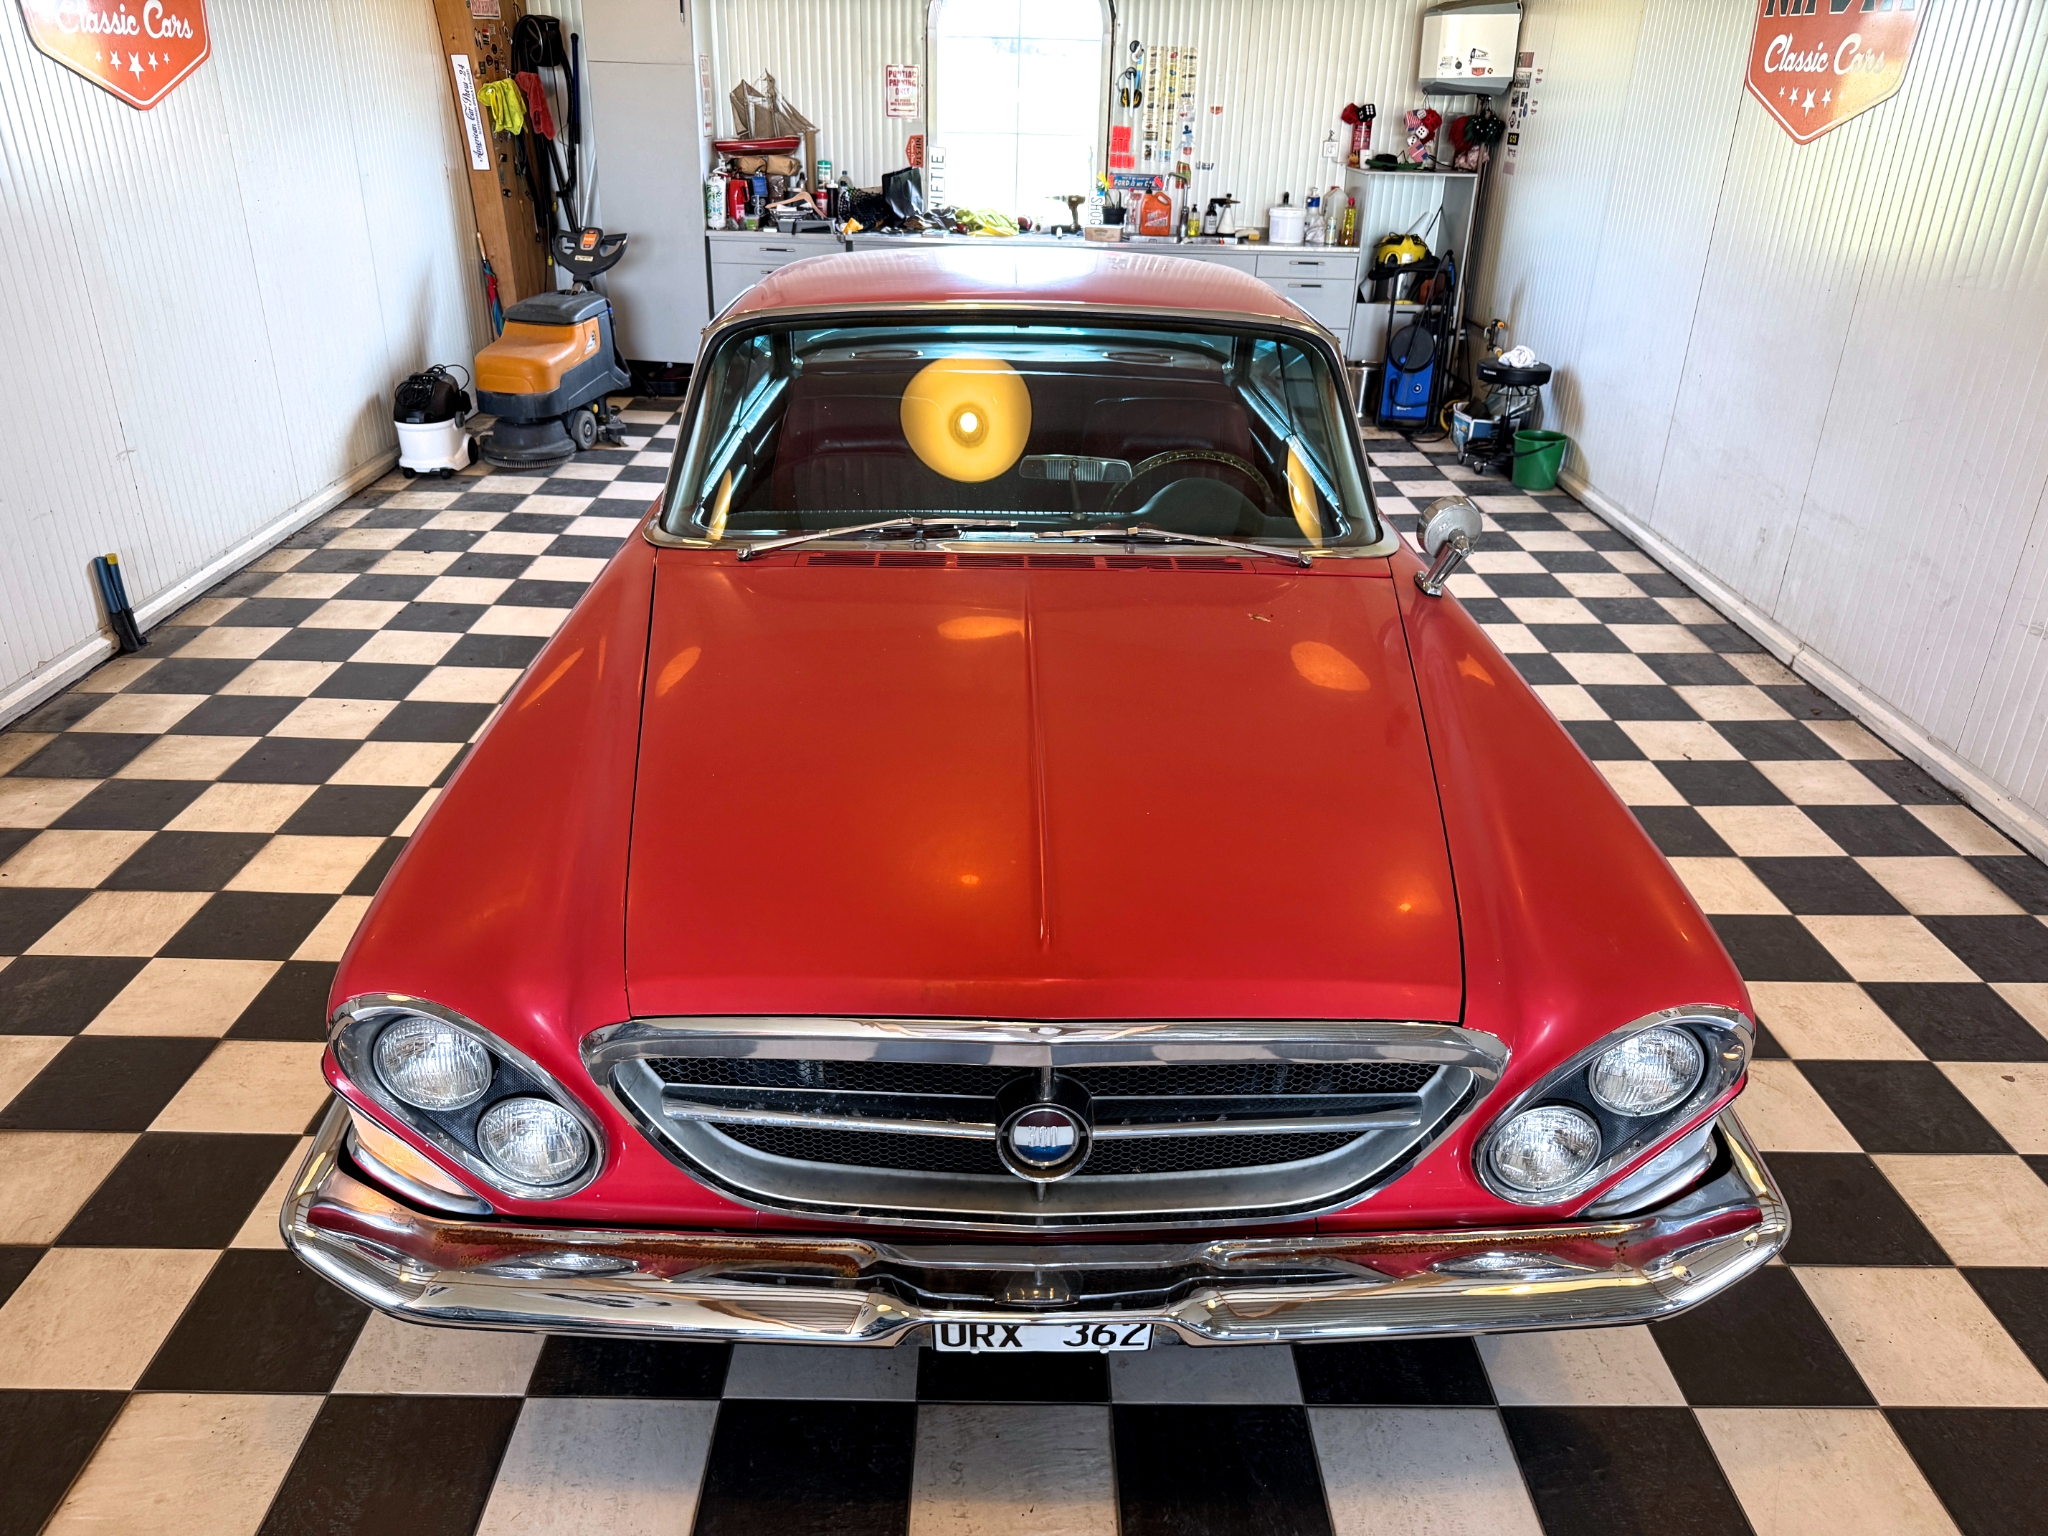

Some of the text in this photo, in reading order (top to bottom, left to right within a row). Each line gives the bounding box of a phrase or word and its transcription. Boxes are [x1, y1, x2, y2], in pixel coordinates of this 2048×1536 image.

[55, 0, 194, 39] Classic Cars
[1764, 33, 1887, 75] Classic Cars
[889, 70, 916, 78] PONTIAC
[889, 79, 917, 87] PARKING
[464, 104, 475, 121] Car
[472, 123, 484, 162] American
[1028, 1126, 1058, 1147] 300
[941, 1324, 1148, 1347] URX 362
